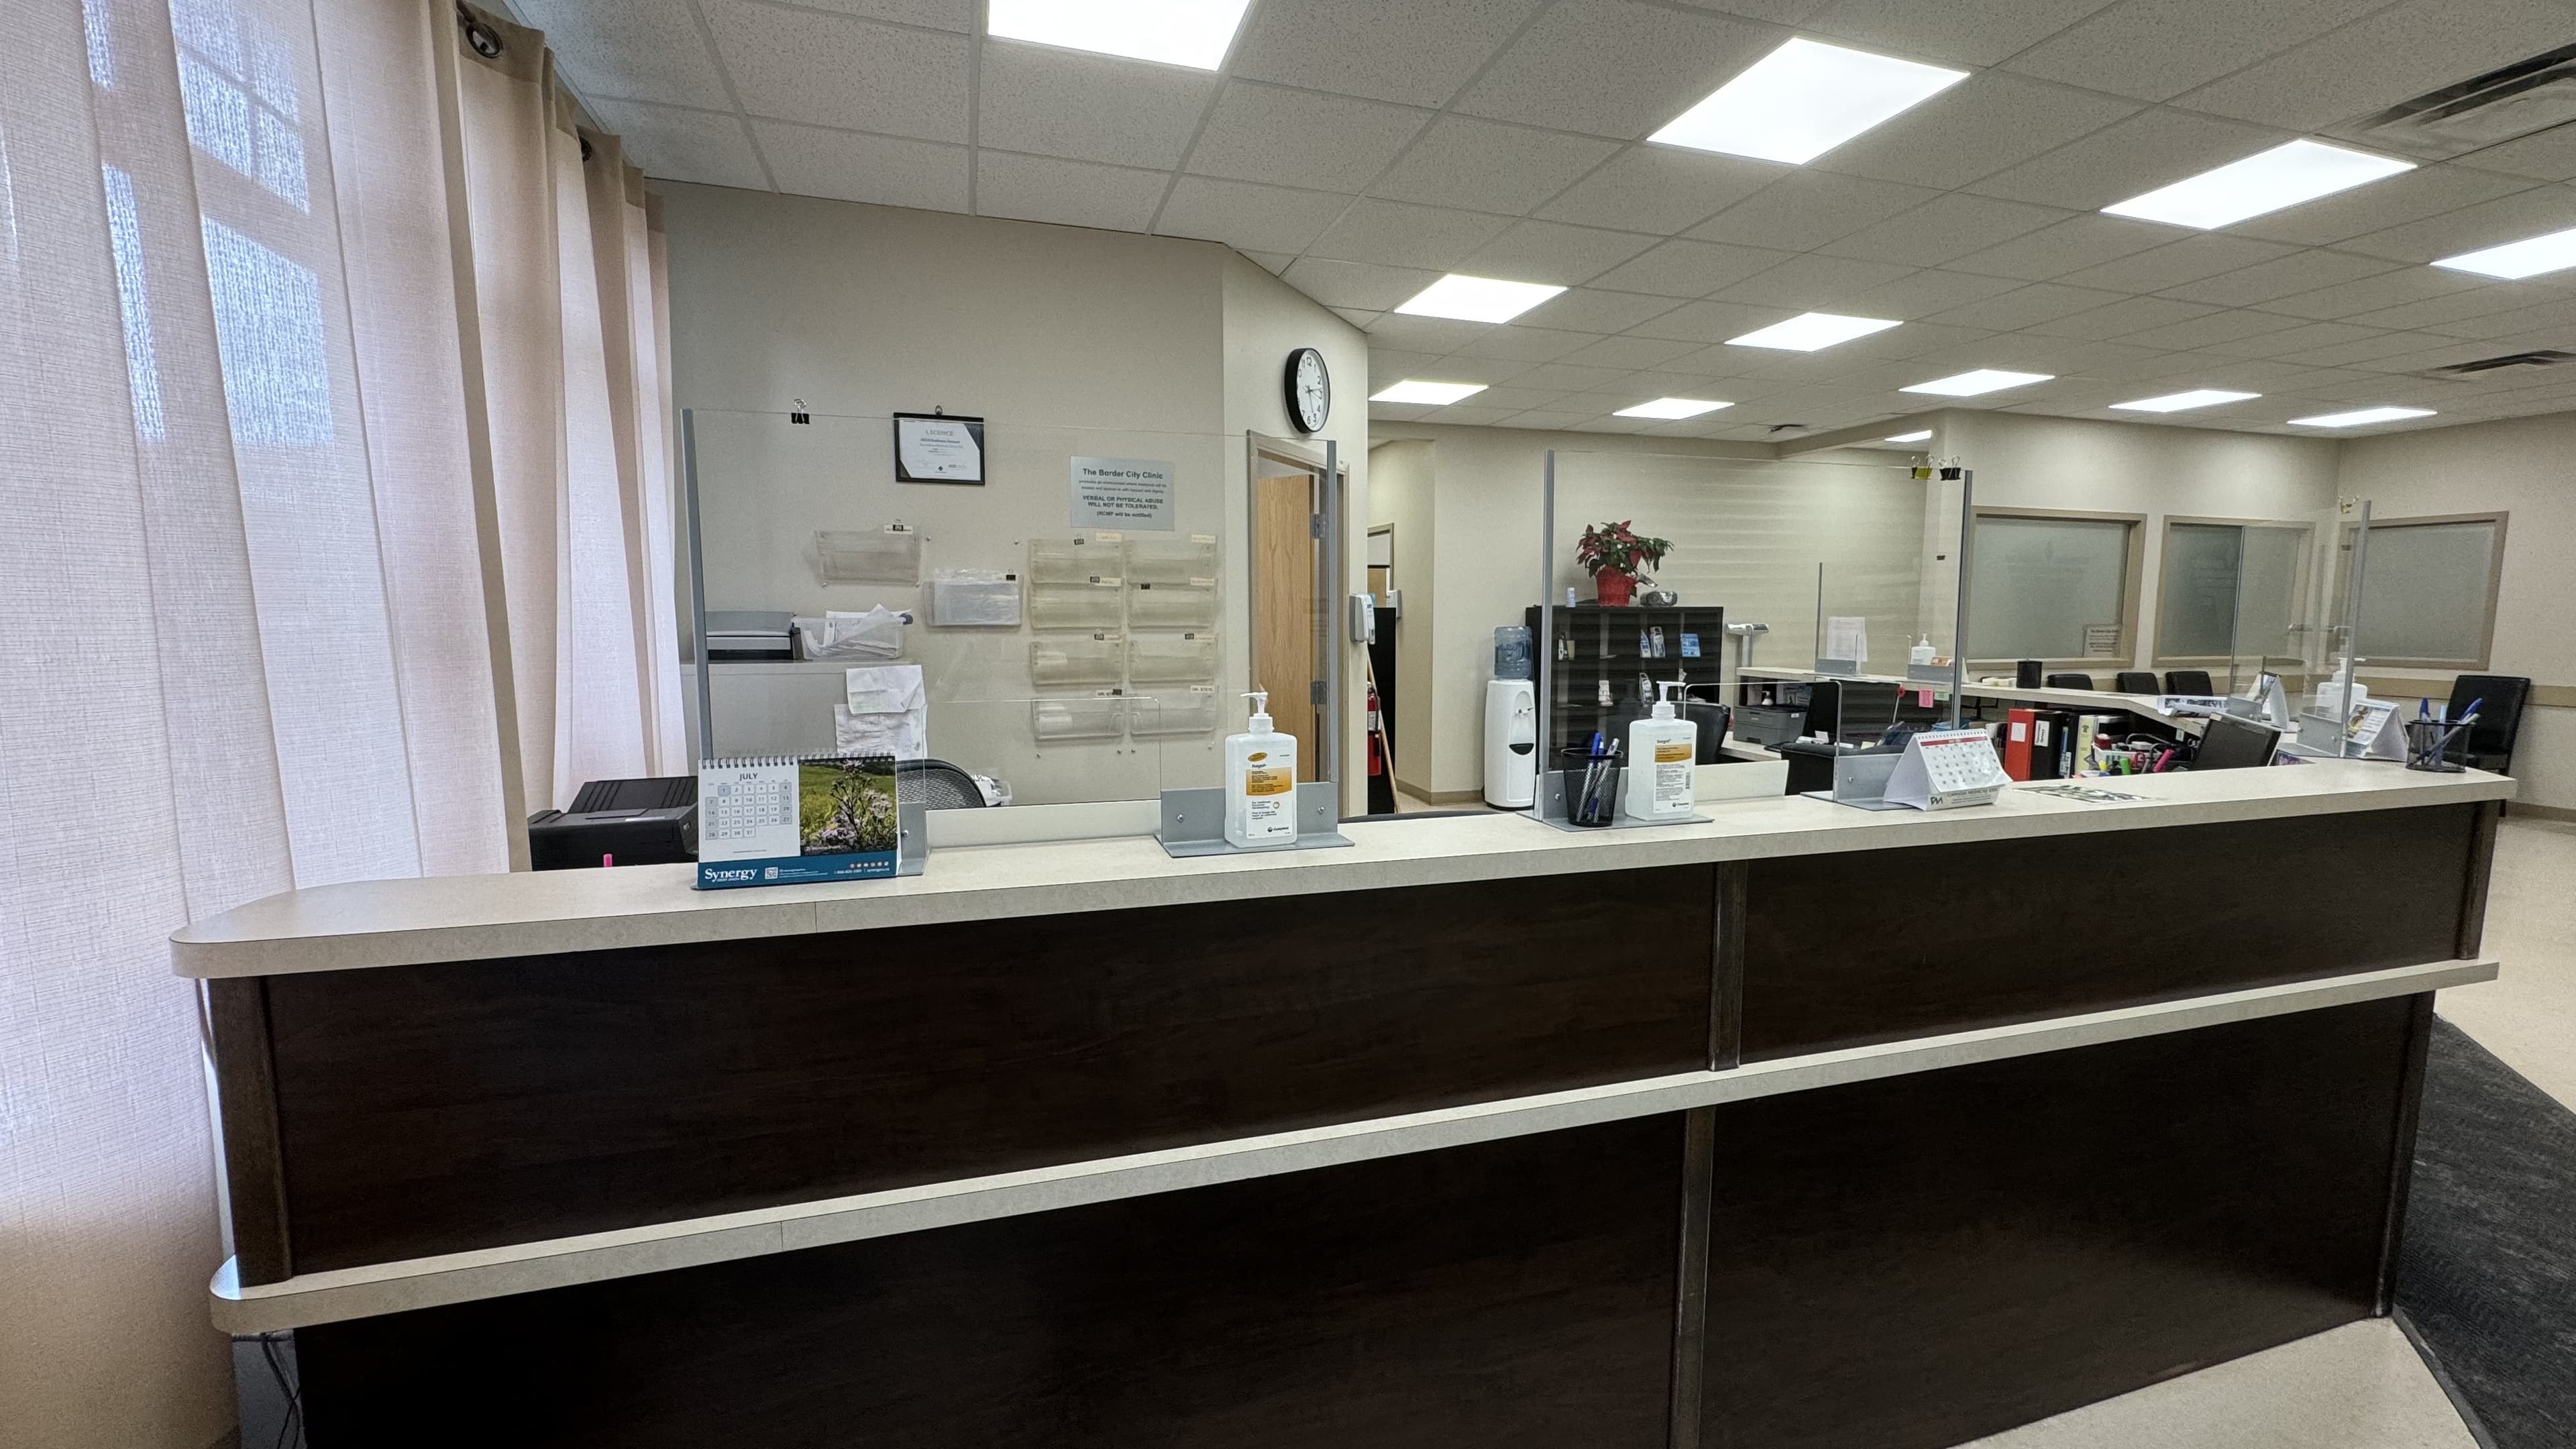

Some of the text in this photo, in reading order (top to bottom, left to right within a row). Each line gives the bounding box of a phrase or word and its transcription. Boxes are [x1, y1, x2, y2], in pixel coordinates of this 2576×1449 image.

[1317, 376, 1321, 385] 2
[1307, 415, 1311, 425] 6
[1099, 469, 1124, 477] Border
[1126, 470, 1140, 480] City
[739, 773, 758, 781] JULY
[704, 868, 758, 882] Synergy
